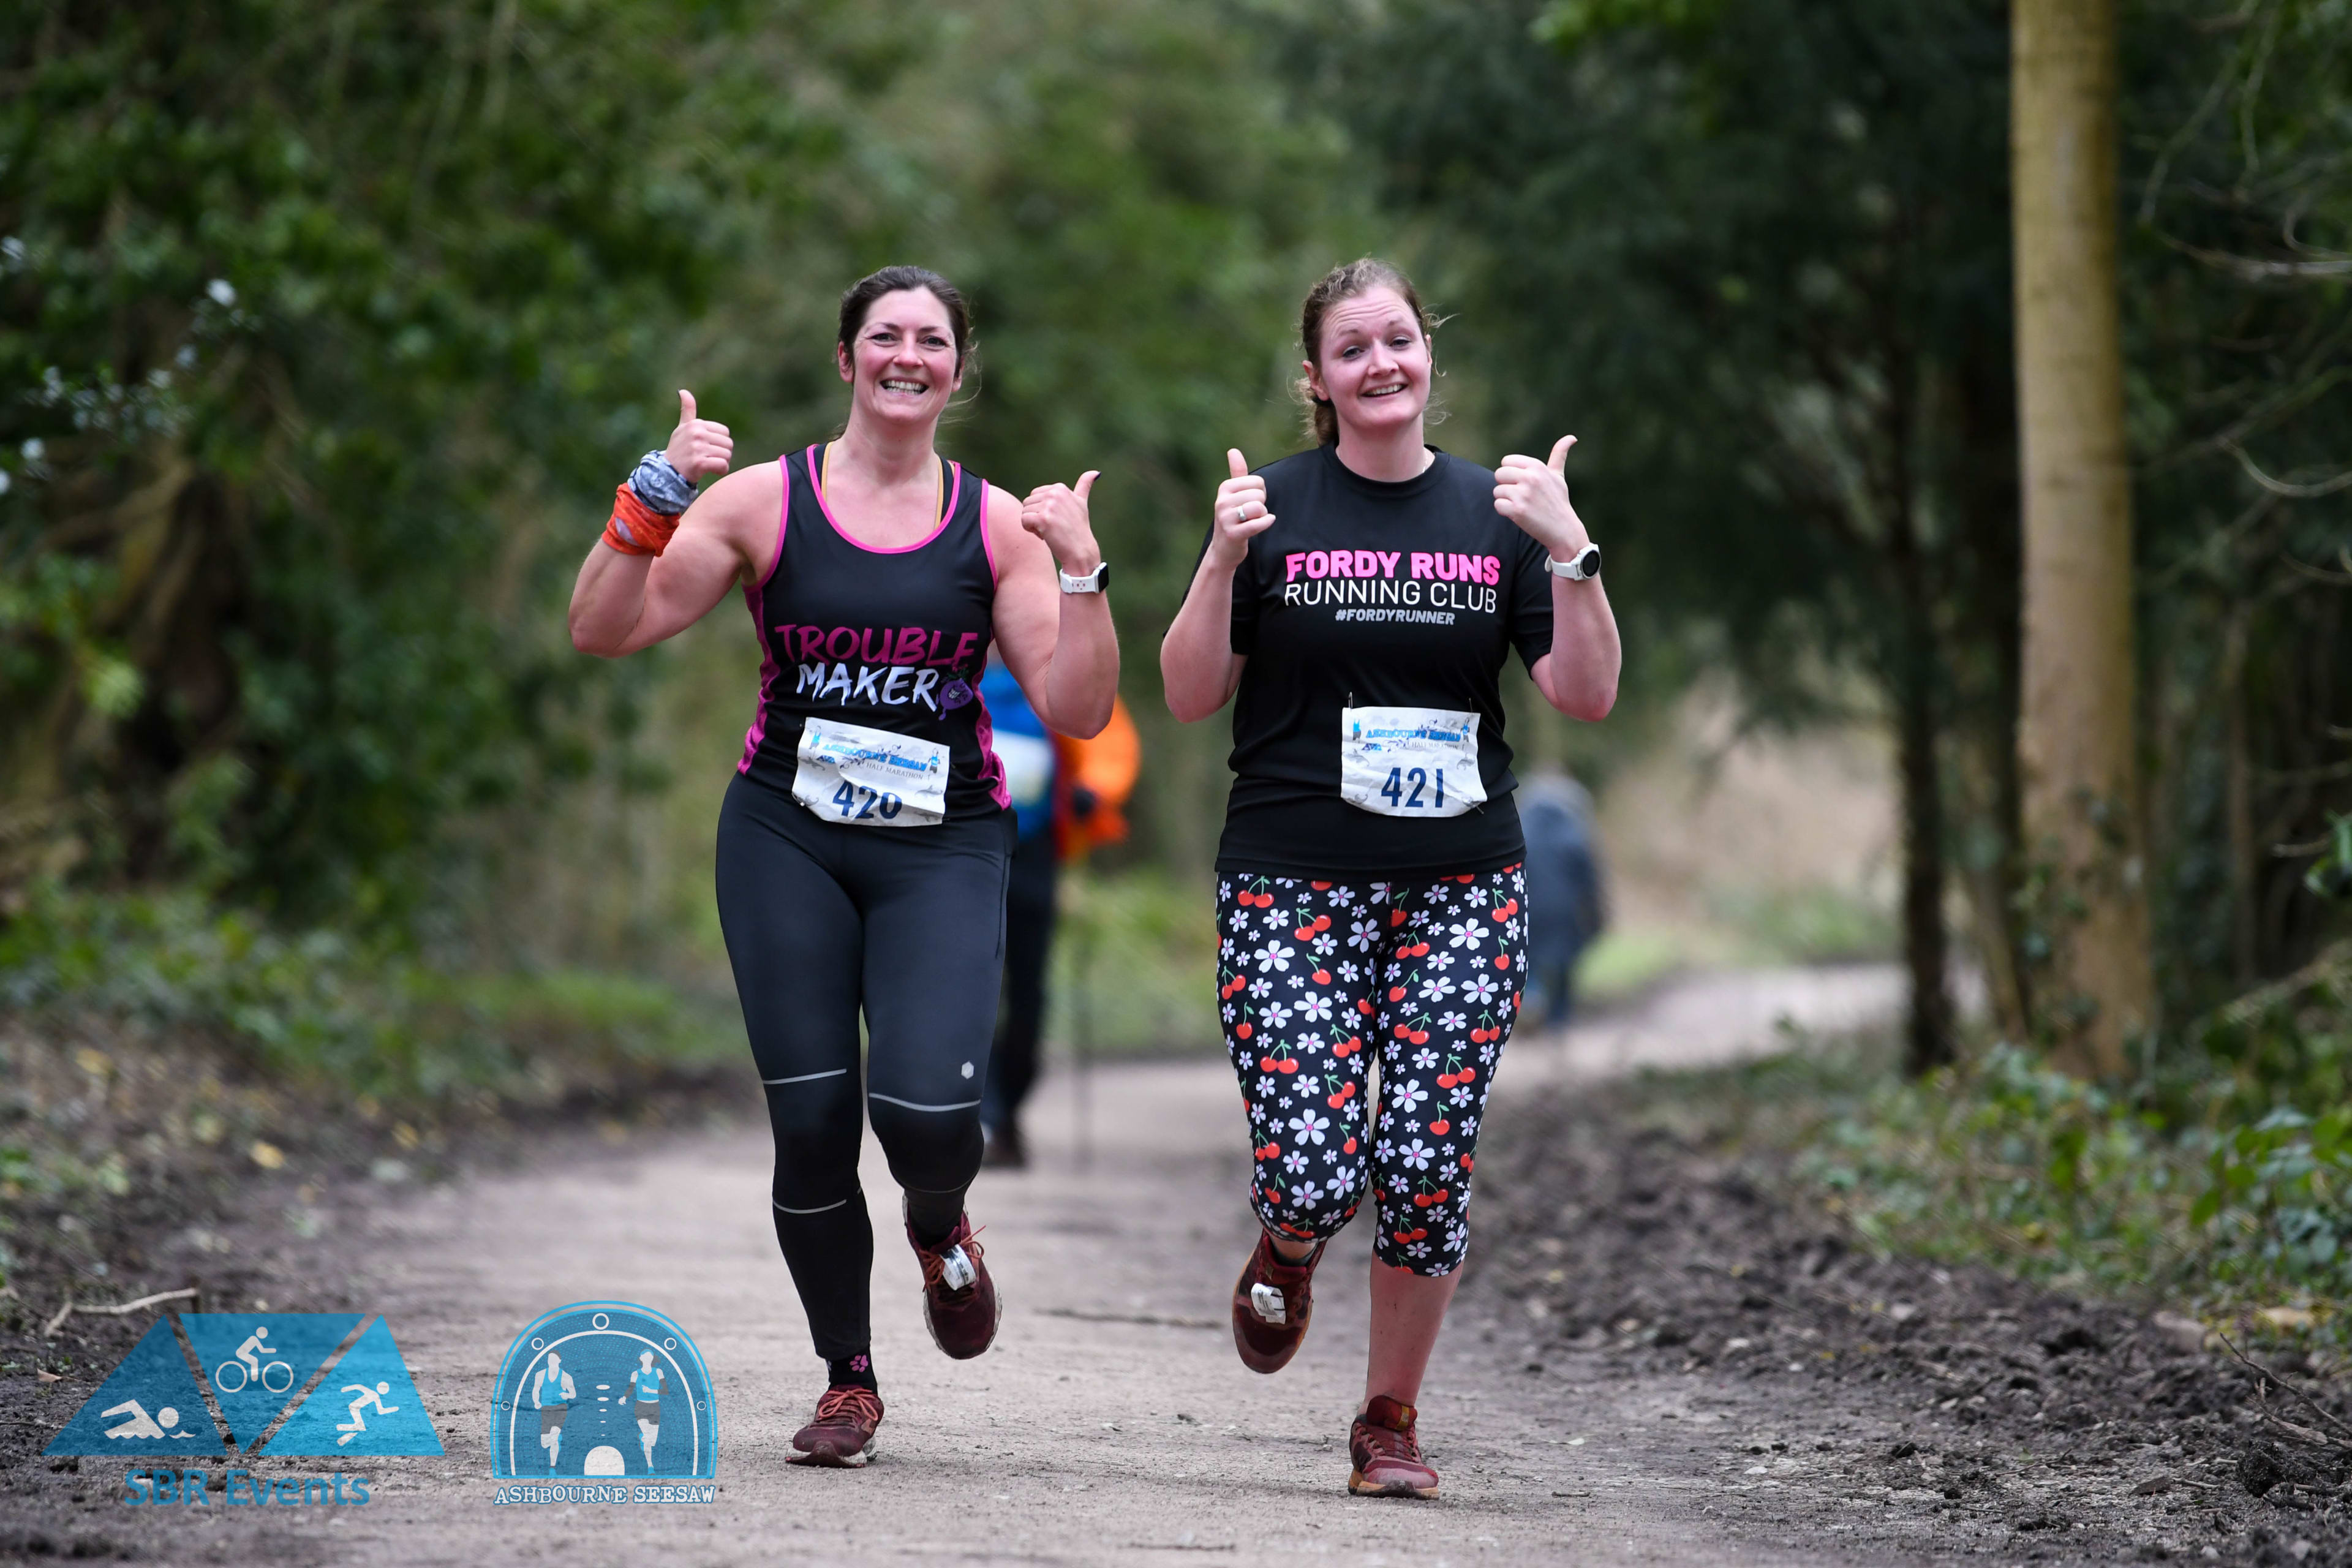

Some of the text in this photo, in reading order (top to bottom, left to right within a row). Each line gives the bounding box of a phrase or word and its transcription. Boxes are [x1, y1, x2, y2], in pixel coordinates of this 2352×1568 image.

[1286, 549, 1500, 585] FORDY RUNS
[1284, 579, 1496, 613] RUNNING CLUB
[1335, 608, 1455, 625] #FORDYRUNNER
[775, 624, 978, 668] TROUBLE
[797, 662, 940, 712] MAKER
[886, 767, 924, 780] MARATHON
[1381, 767, 1444, 808] 421
[832, 782, 902, 820] 420
